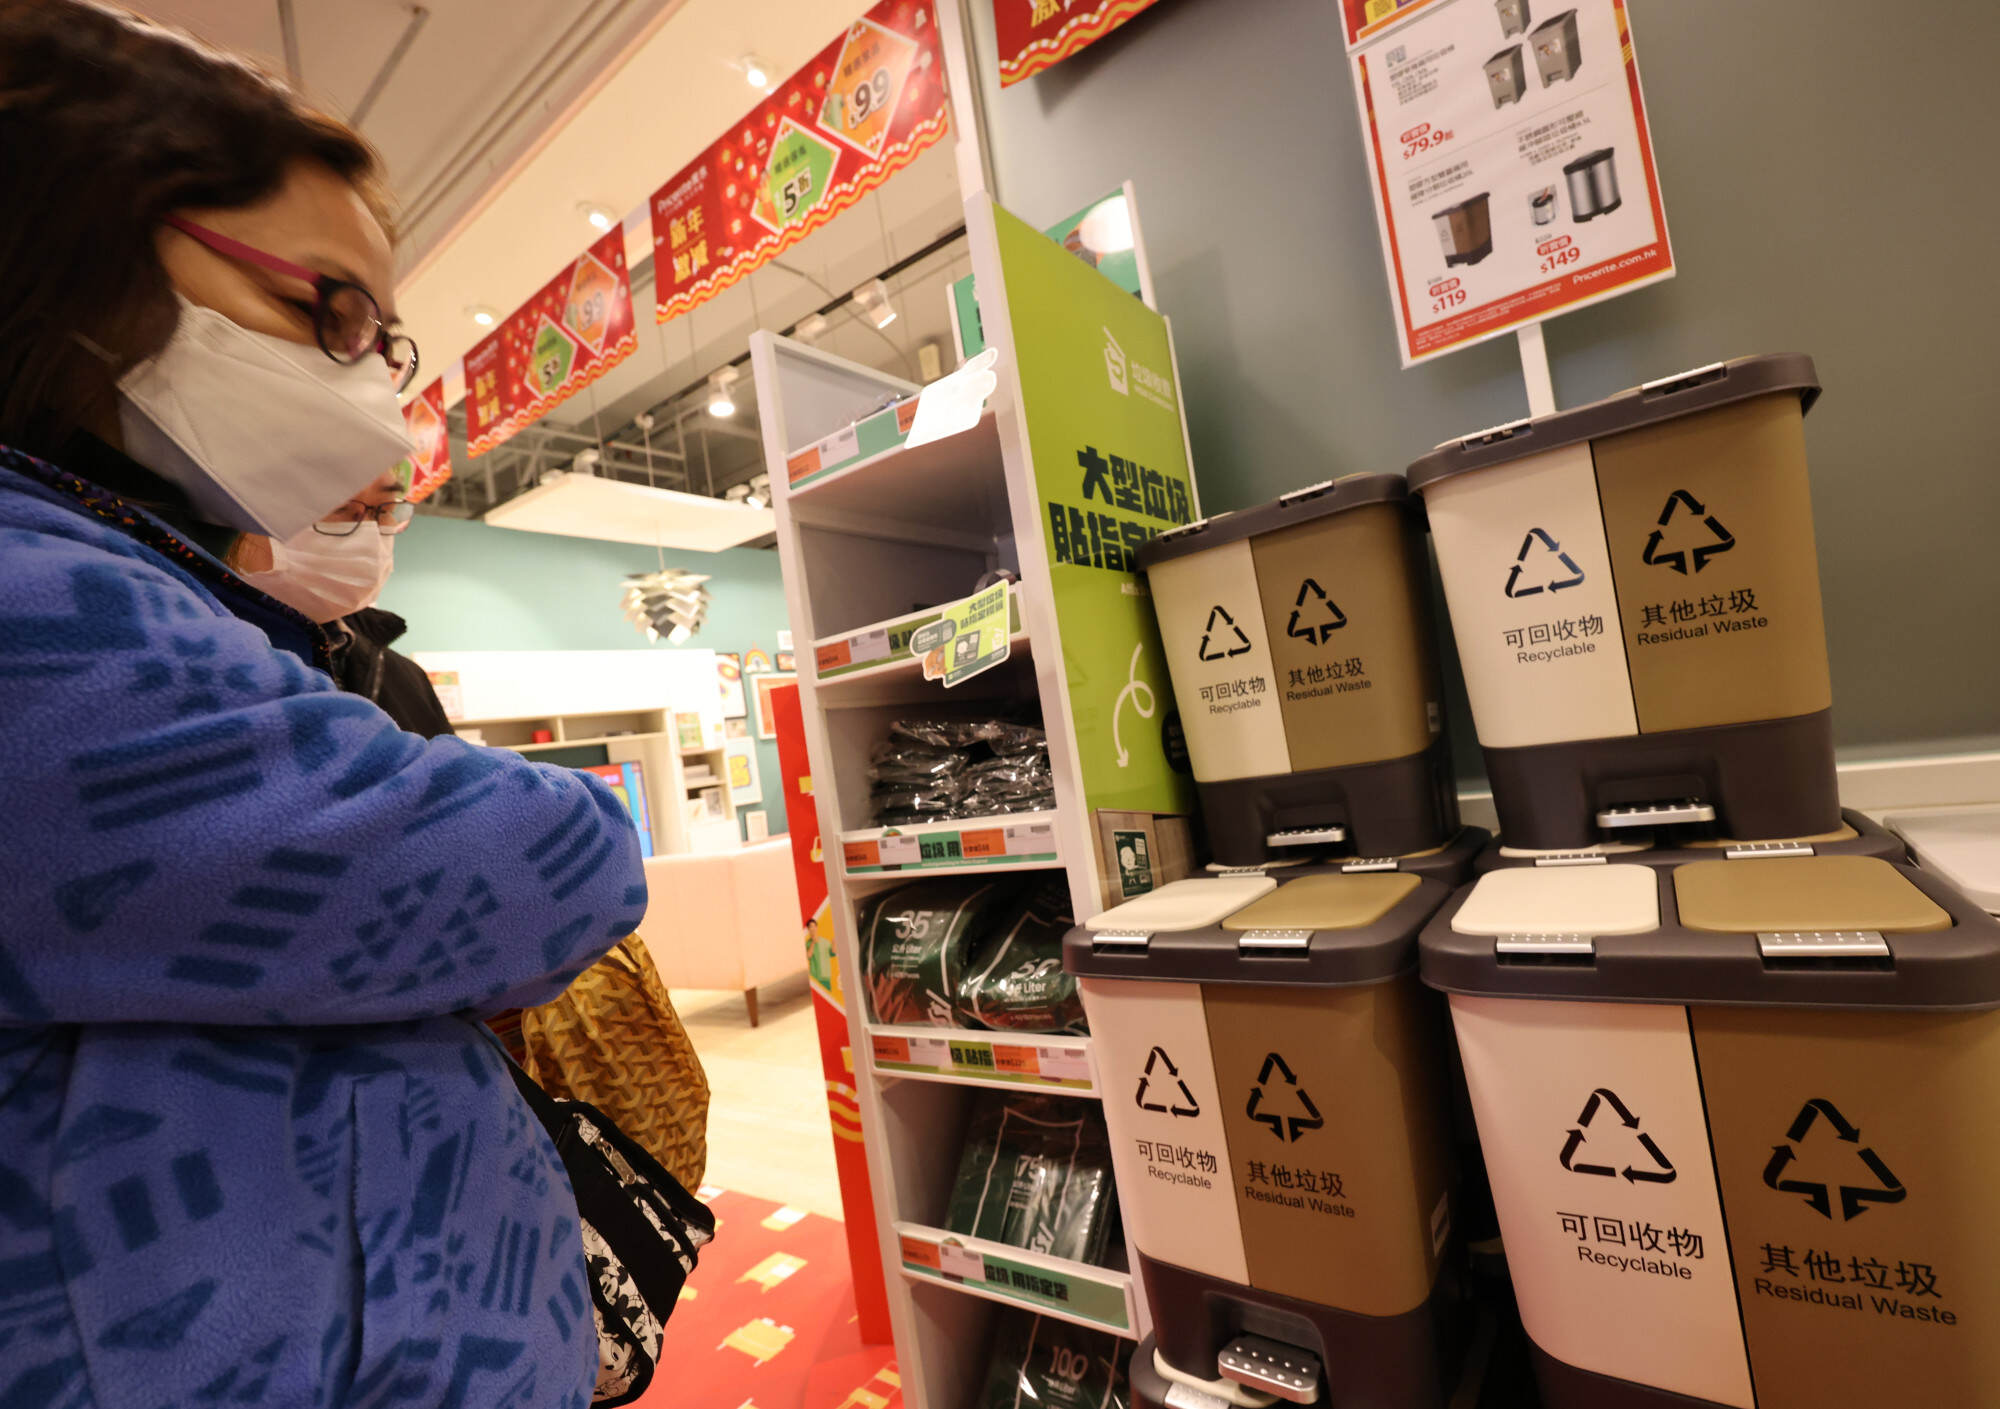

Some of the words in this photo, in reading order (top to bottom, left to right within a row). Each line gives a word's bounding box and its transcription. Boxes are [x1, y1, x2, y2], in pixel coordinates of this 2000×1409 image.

[1540, 247, 1580, 274] $149
[1432, 289, 1466, 314] $119
[1077, 445, 1192, 524] 大型垃圾
[1048, 501, 1162, 573] 貼指定
[1640, 589, 1758, 628] 其他垃圾
[1502, 614, 1604, 649] 可回收物
[1637, 624, 1708, 645] Residual
[1713, 615, 1768, 634] Waste
[1517, 642, 1596, 664] Recyclable
[1288, 658, 1365, 687] 其他垃圾
[1199, 676, 1265, 702] 可回收物
[1286, 685, 1333, 701] Residual
[1336, 678, 1371, 692] Waste
[1209, 697, 1261, 714] Recyclable
[896, 910, 932, 939] 35
[1023, 982, 1047, 994] Liter
[1135, 1139, 1217, 1173] 可回收物
[1148, 1165, 1211, 1189] Recyclable
[1247, 1160, 1346, 1199] 其他垃圾
[1245, 1187, 1304, 1209] Residual
[1309, 1199, 1355, 1218] Waste
[1556, 1211, 1704, 1259] 可回收物
[1577, 1246, 1692, 1280] Recyclable
[1760, 1244, 1942, 1298] 其他垃圾
[1754, 1278, 1863, 1311] Residual
[1870, 1297, 1957, 1326] Waste
[1050, 1346, 1089, 1381] 100
